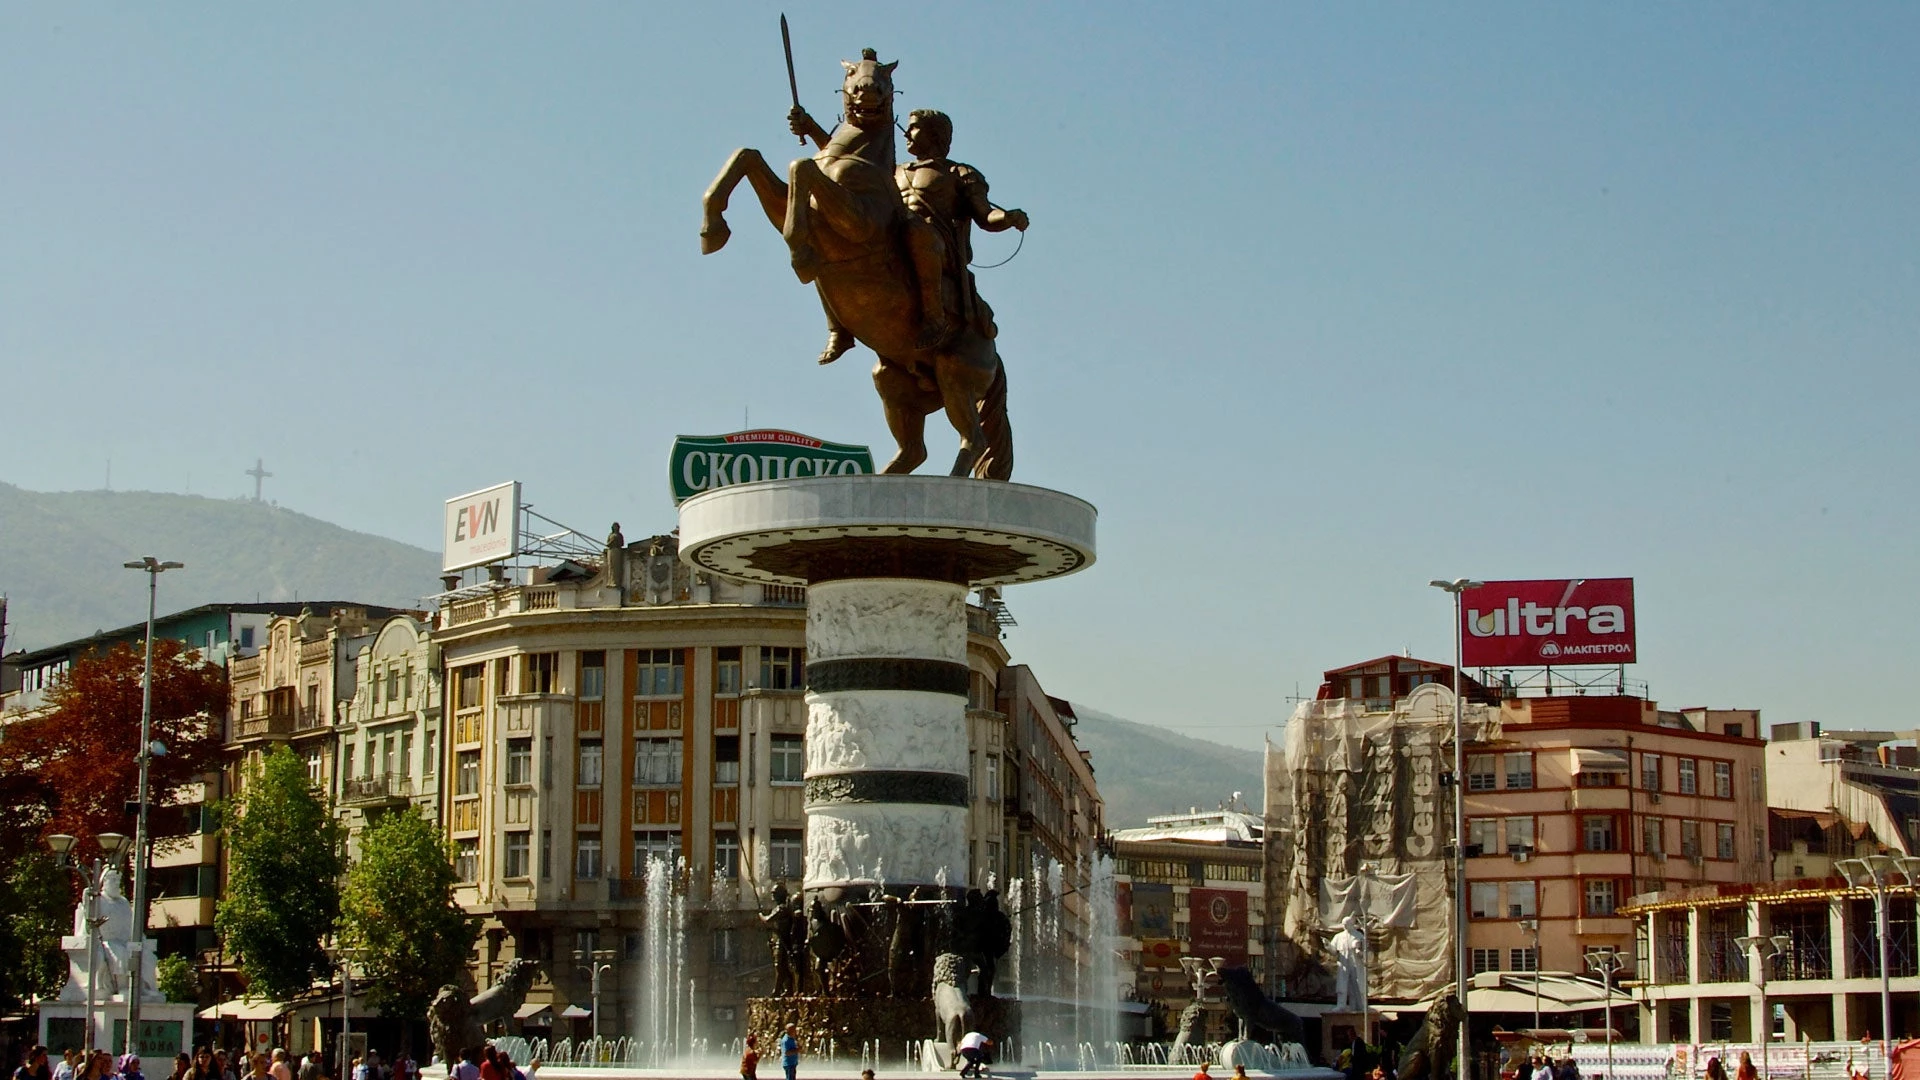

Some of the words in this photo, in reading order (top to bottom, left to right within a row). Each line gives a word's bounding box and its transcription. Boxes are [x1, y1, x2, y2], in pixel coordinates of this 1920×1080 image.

[732, 432, 775, 443] PREMIUM
[778, 434, 816, 447] QUALITY
[454, 498, 500, 542] EVN
[1467, 597, 1625, 637] ultra
[1563, 643, 1631, 655] МАКПЕТРОЛ
